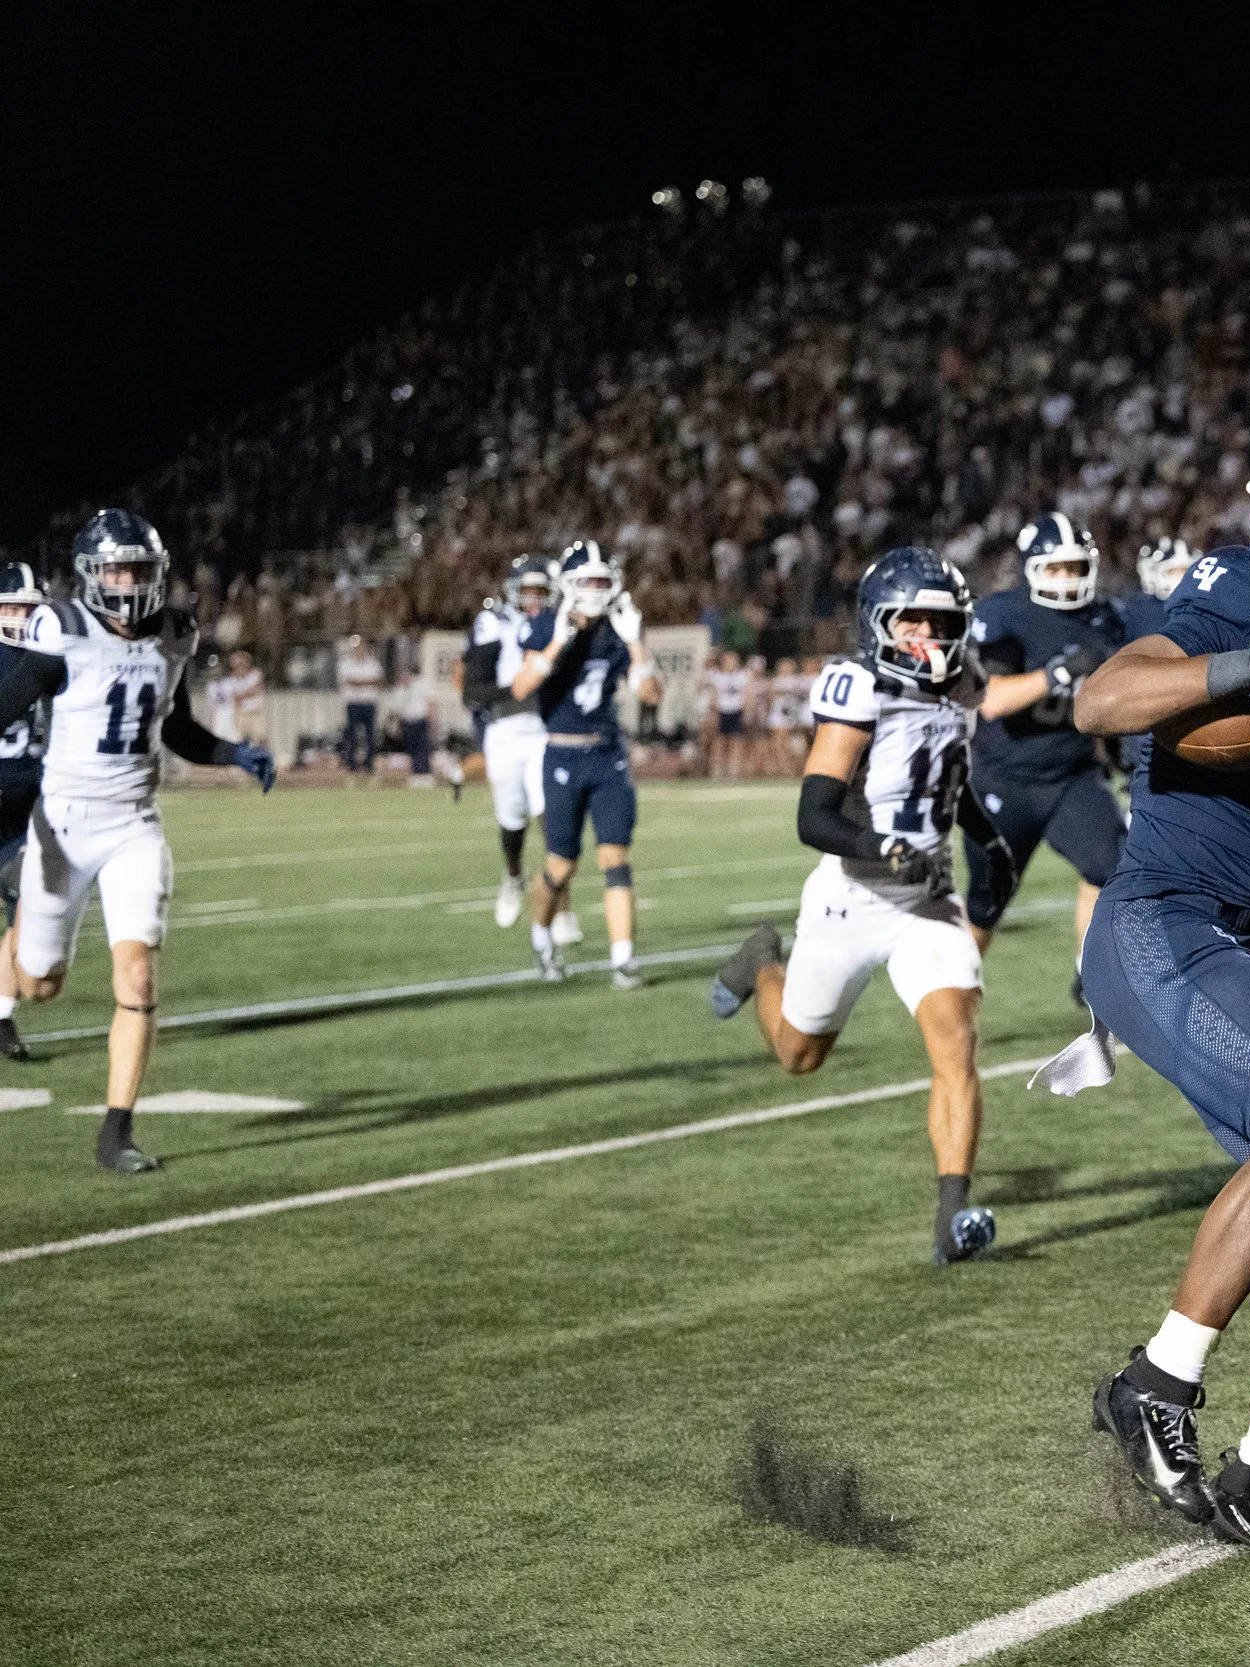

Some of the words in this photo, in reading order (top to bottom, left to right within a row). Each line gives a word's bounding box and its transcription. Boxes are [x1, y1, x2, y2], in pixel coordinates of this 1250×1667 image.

[1193, 556, 1227, 592] SV
[820, 672, 854, 707] 10
[97, 682, 156, 754] 11
